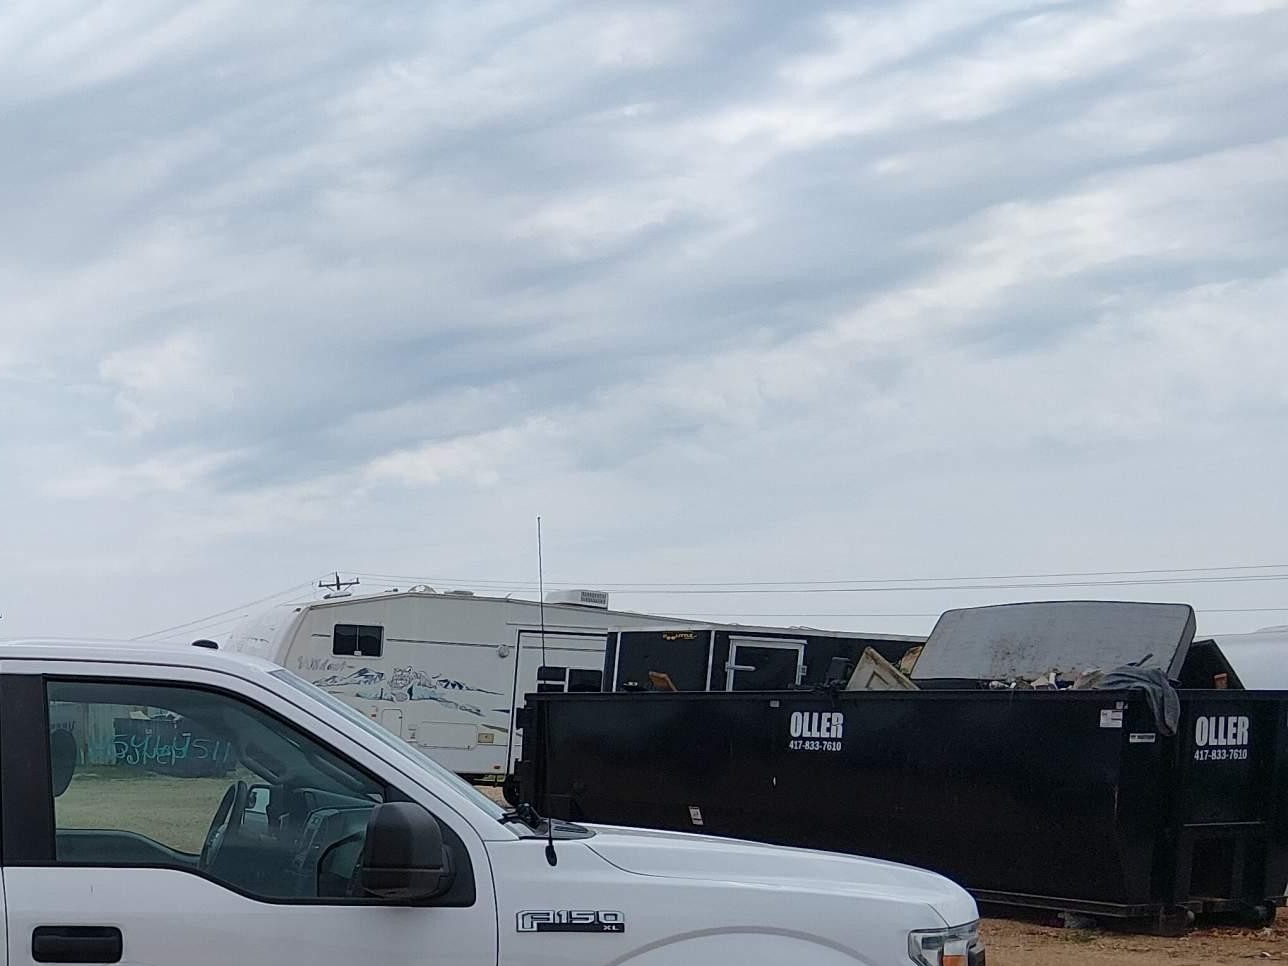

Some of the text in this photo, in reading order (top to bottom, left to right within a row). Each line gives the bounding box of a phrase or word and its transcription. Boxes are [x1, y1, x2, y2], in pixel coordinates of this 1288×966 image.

[790, 711, 844, 739] OLLER
[1195, 716, 1250, 747] OLLER
[789, 740, 842, 752] 417-833-7610
[1194, 749, 1248, 761] 417-833-7610
